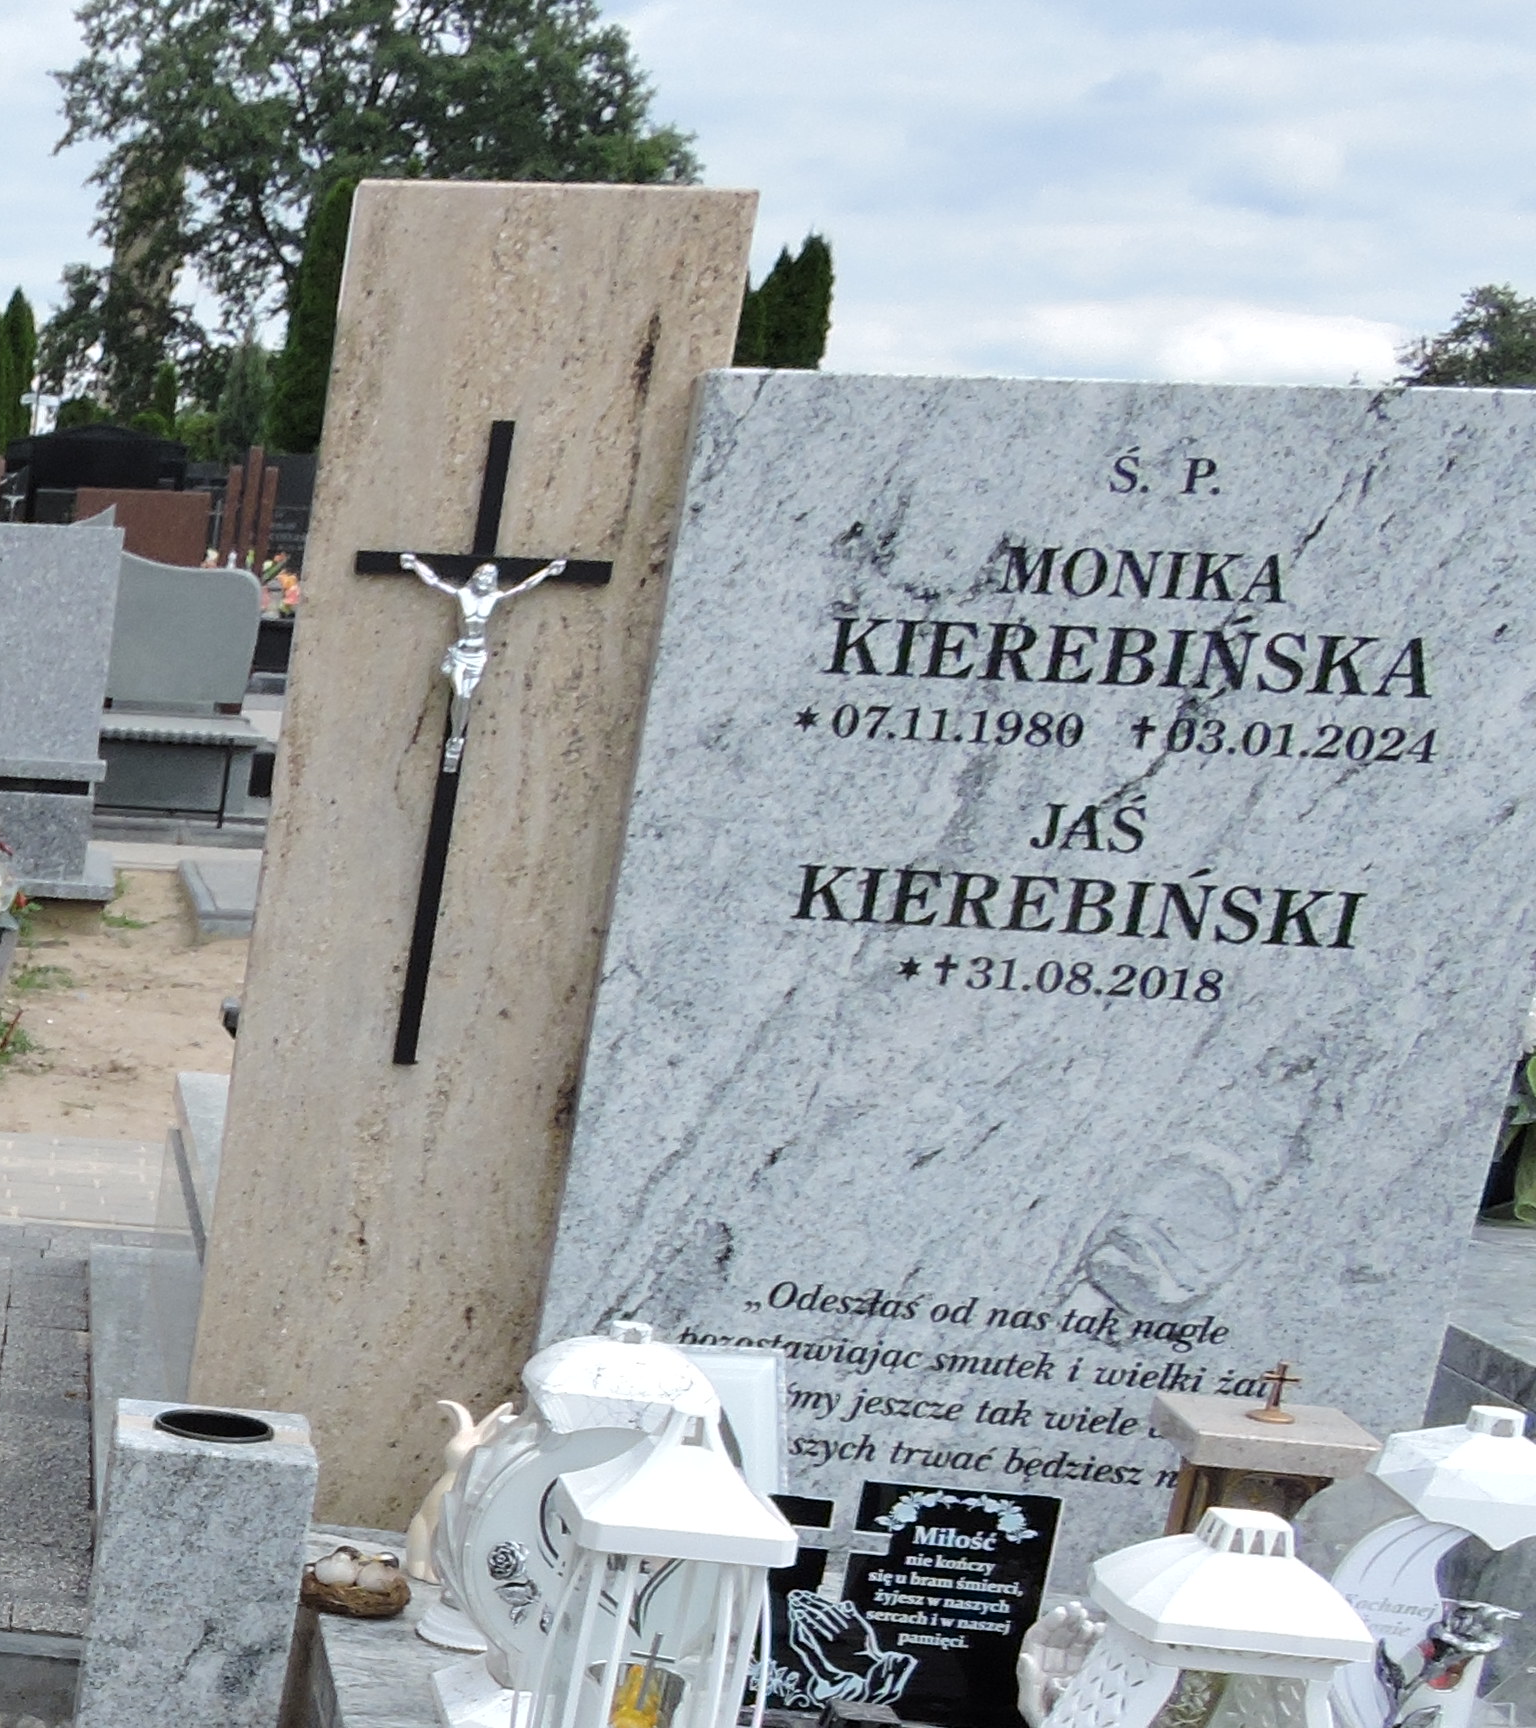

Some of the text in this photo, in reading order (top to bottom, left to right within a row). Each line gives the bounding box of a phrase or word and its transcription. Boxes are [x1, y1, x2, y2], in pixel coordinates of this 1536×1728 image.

[1108, 447, 1222, 496] Ś. P.
[997, 544, 1287, 604] MONIKA
[824, 614, 1435, 700] KIEREBIŃSKA
[831, 703, 1439, 765] 07.11.1980 03.01.2024
[1030, 795, 1148, 854] JAŚ
[790, 864, 1368, 950] KIEREBIŃSKI
[967, 955, 1225, 1004] 31.08.2018
[930, 1297, 979, 1325] od
[986, 1306, 1051, 1332] nas
[1061, 1307, 1119, 1336] tak
[1132, 1315, 1229, 1353] nagle
[929, 1351, 1055, 1383] smutek
[1068, 1357, 1084, 1383] i
[1096, 1362, 1207, 1393] wielki
[840, 1388, 965, 1423] jeszcze
[975, 1400, 1029, 1428] tak
[1044, 1406, 1140, 1437] wiele
[889, 1441, 997, 1473] trwać
[1004, 1447, 1145, 1486] będziesz
[912, 1525, 997, 1551] Miłość
[868, 1569, 1024, 1597] się u bram śmierci,
[904, 1553, 996, 1576] nie kończy
[865, 1609, 1011, 1636] sercach i w naszej
[873, 1589, 1010, 1614] żyjesz w naszych
[897, 1632, 969, 1650] pamięci.
